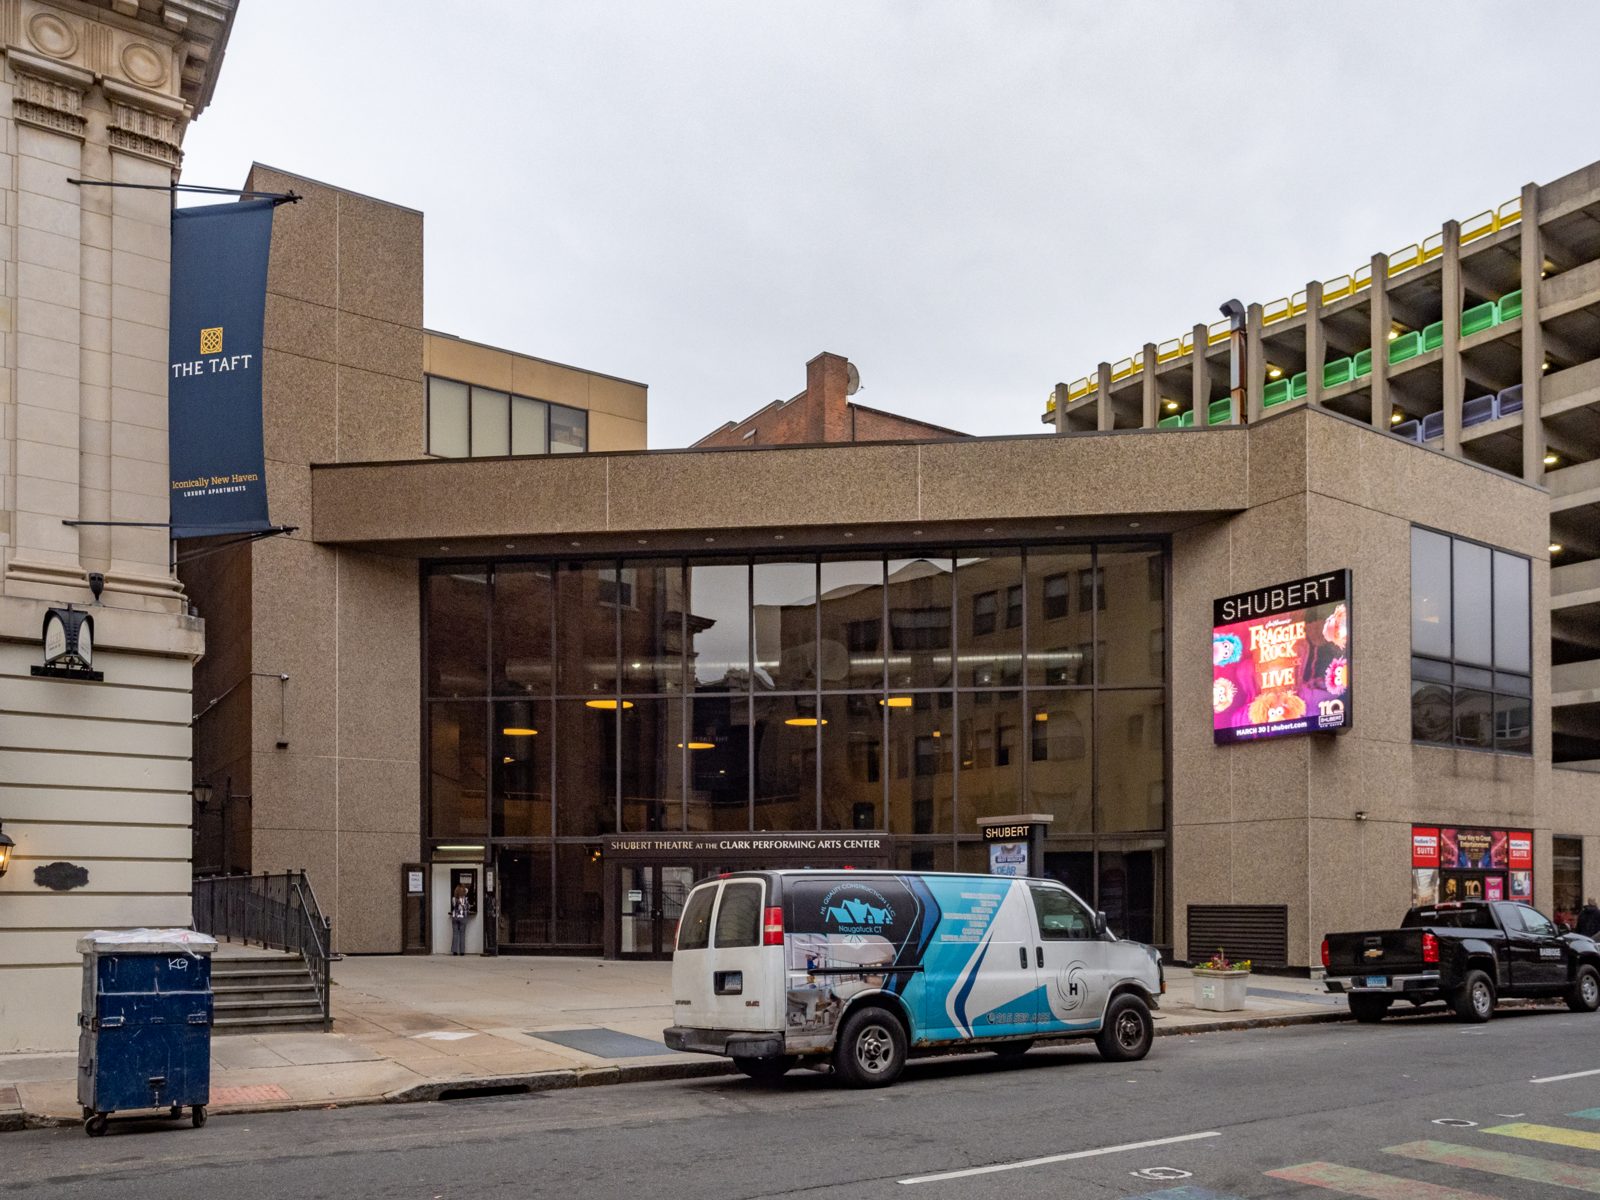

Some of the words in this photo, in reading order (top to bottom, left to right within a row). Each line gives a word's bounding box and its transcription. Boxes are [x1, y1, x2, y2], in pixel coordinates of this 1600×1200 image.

[171, 360, 204, 378] THE
[208, 354, 253, 373] TAFT
[172, 477, 209, 489] Iconically
[211, 476, 230, 485] New
[232, 473, 258, 483] Haven
[183, 489, 206, 498] LUXURY
[208, 485, 247, 495] APARTMENTS
[1222, 576, 1335, 621] SHUBERT
[1248, 621, 1306, 651] FRAGGLE
[1258, 640, 1298, 664] ROCK
[1261, 667, 1295, 690] LIVE
[1236, 727, 1257, 736] MARCH
[1271, 721, 1308, 732] shubert.com
[985, 826, 1030, 838] SHUBERT
[611, 841, 652, 850] SHUBERT
[654, 841, 694, 850] THEATRE
[719, 840, 751, 849] CLARK
[752, 840, 816, 849] PERFORMING
[817, 840, 842, 849] ARTS
[843, 839, 881, 849] CENTER
[1416, 847, 1435, 855] SUITE
[823, 886, 842, 905] QUALITY
[842, 883, 887, 904] CONSTRUCTION
[885, 902, 896, 917] LLC
[838, 925, 873, 933] Naugatuck
[1069, 982, 1078, 996] H
